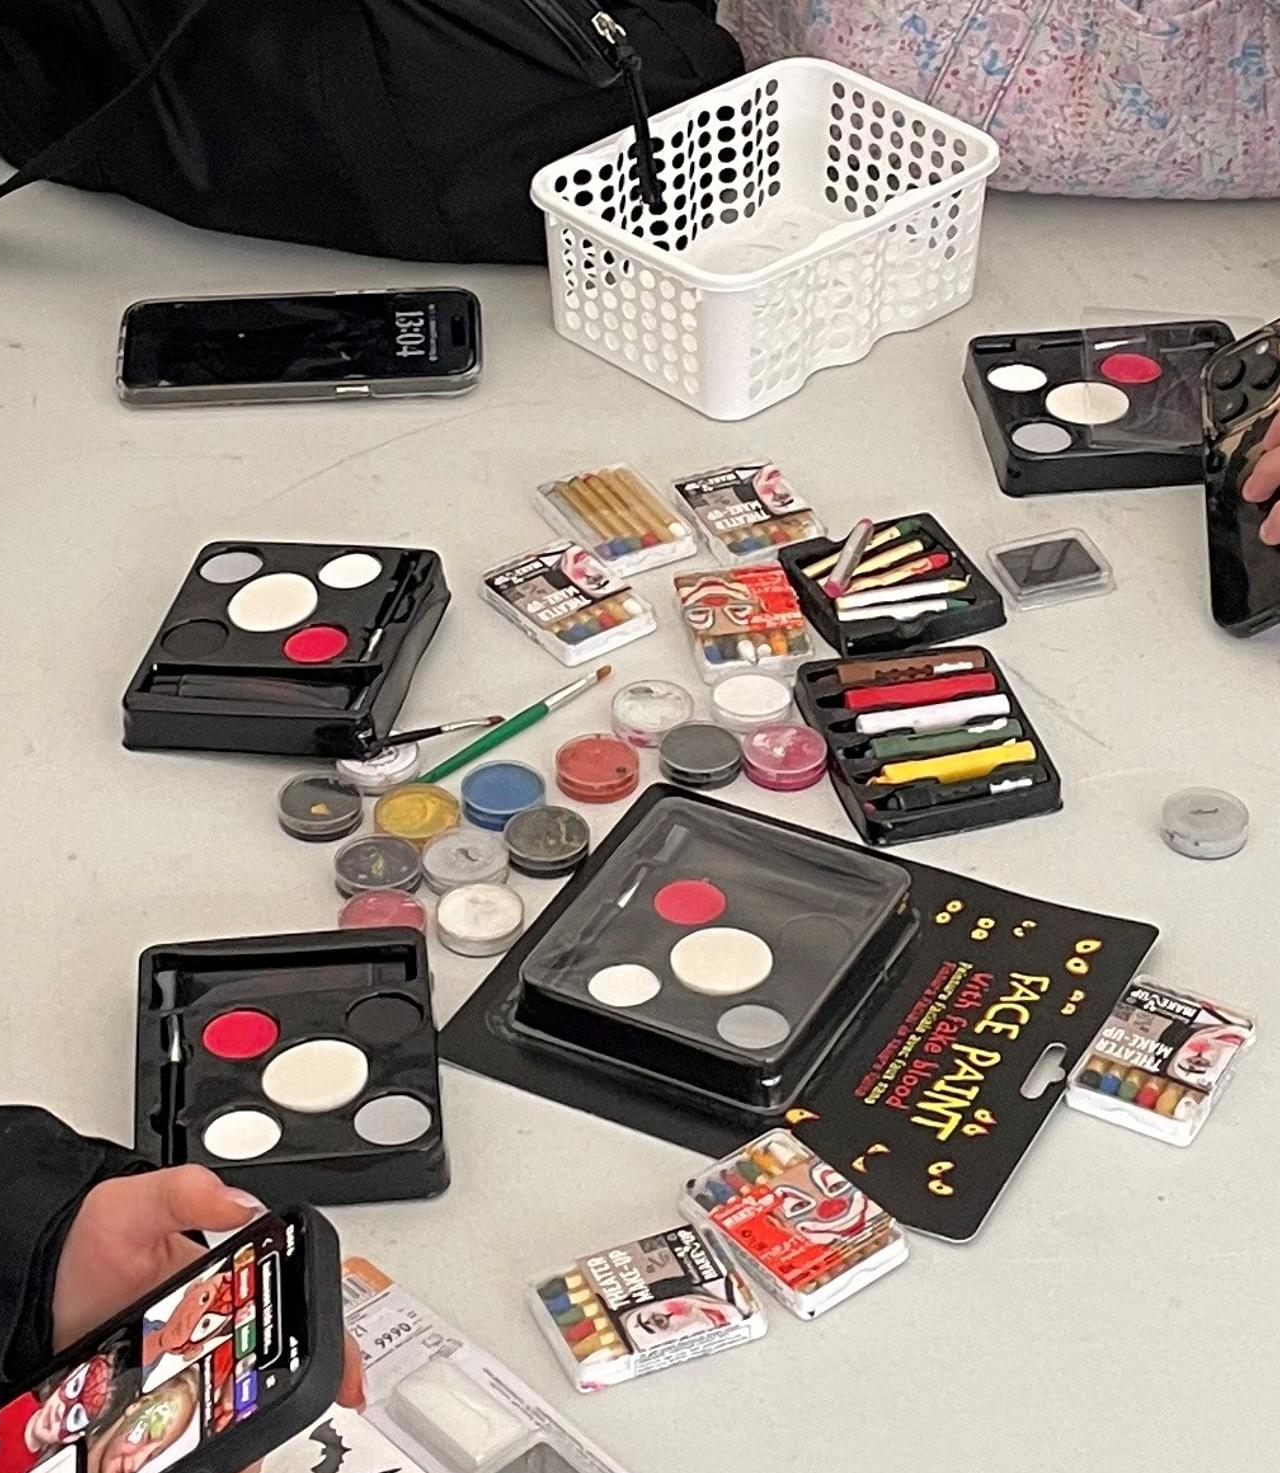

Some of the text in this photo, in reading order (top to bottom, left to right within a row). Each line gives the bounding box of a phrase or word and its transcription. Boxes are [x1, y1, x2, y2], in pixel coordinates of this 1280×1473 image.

[394, 311, 426, 358] 13:04
[1161, 999, 1197, 1018] MAKE
[910, 972, 1051, 1141] FACE PAINT
[924, 1013, 968, 1054] fake
[1095, 1038, 1162, 1073] THEATER
[1103, 1026, 1174, 1059] MAKE-UP
[884, 1058, 940, 1110] blood
[586, 1256, 631, 1312] THEATER
[608, 1249, 655, 1304] MAKE-UP
